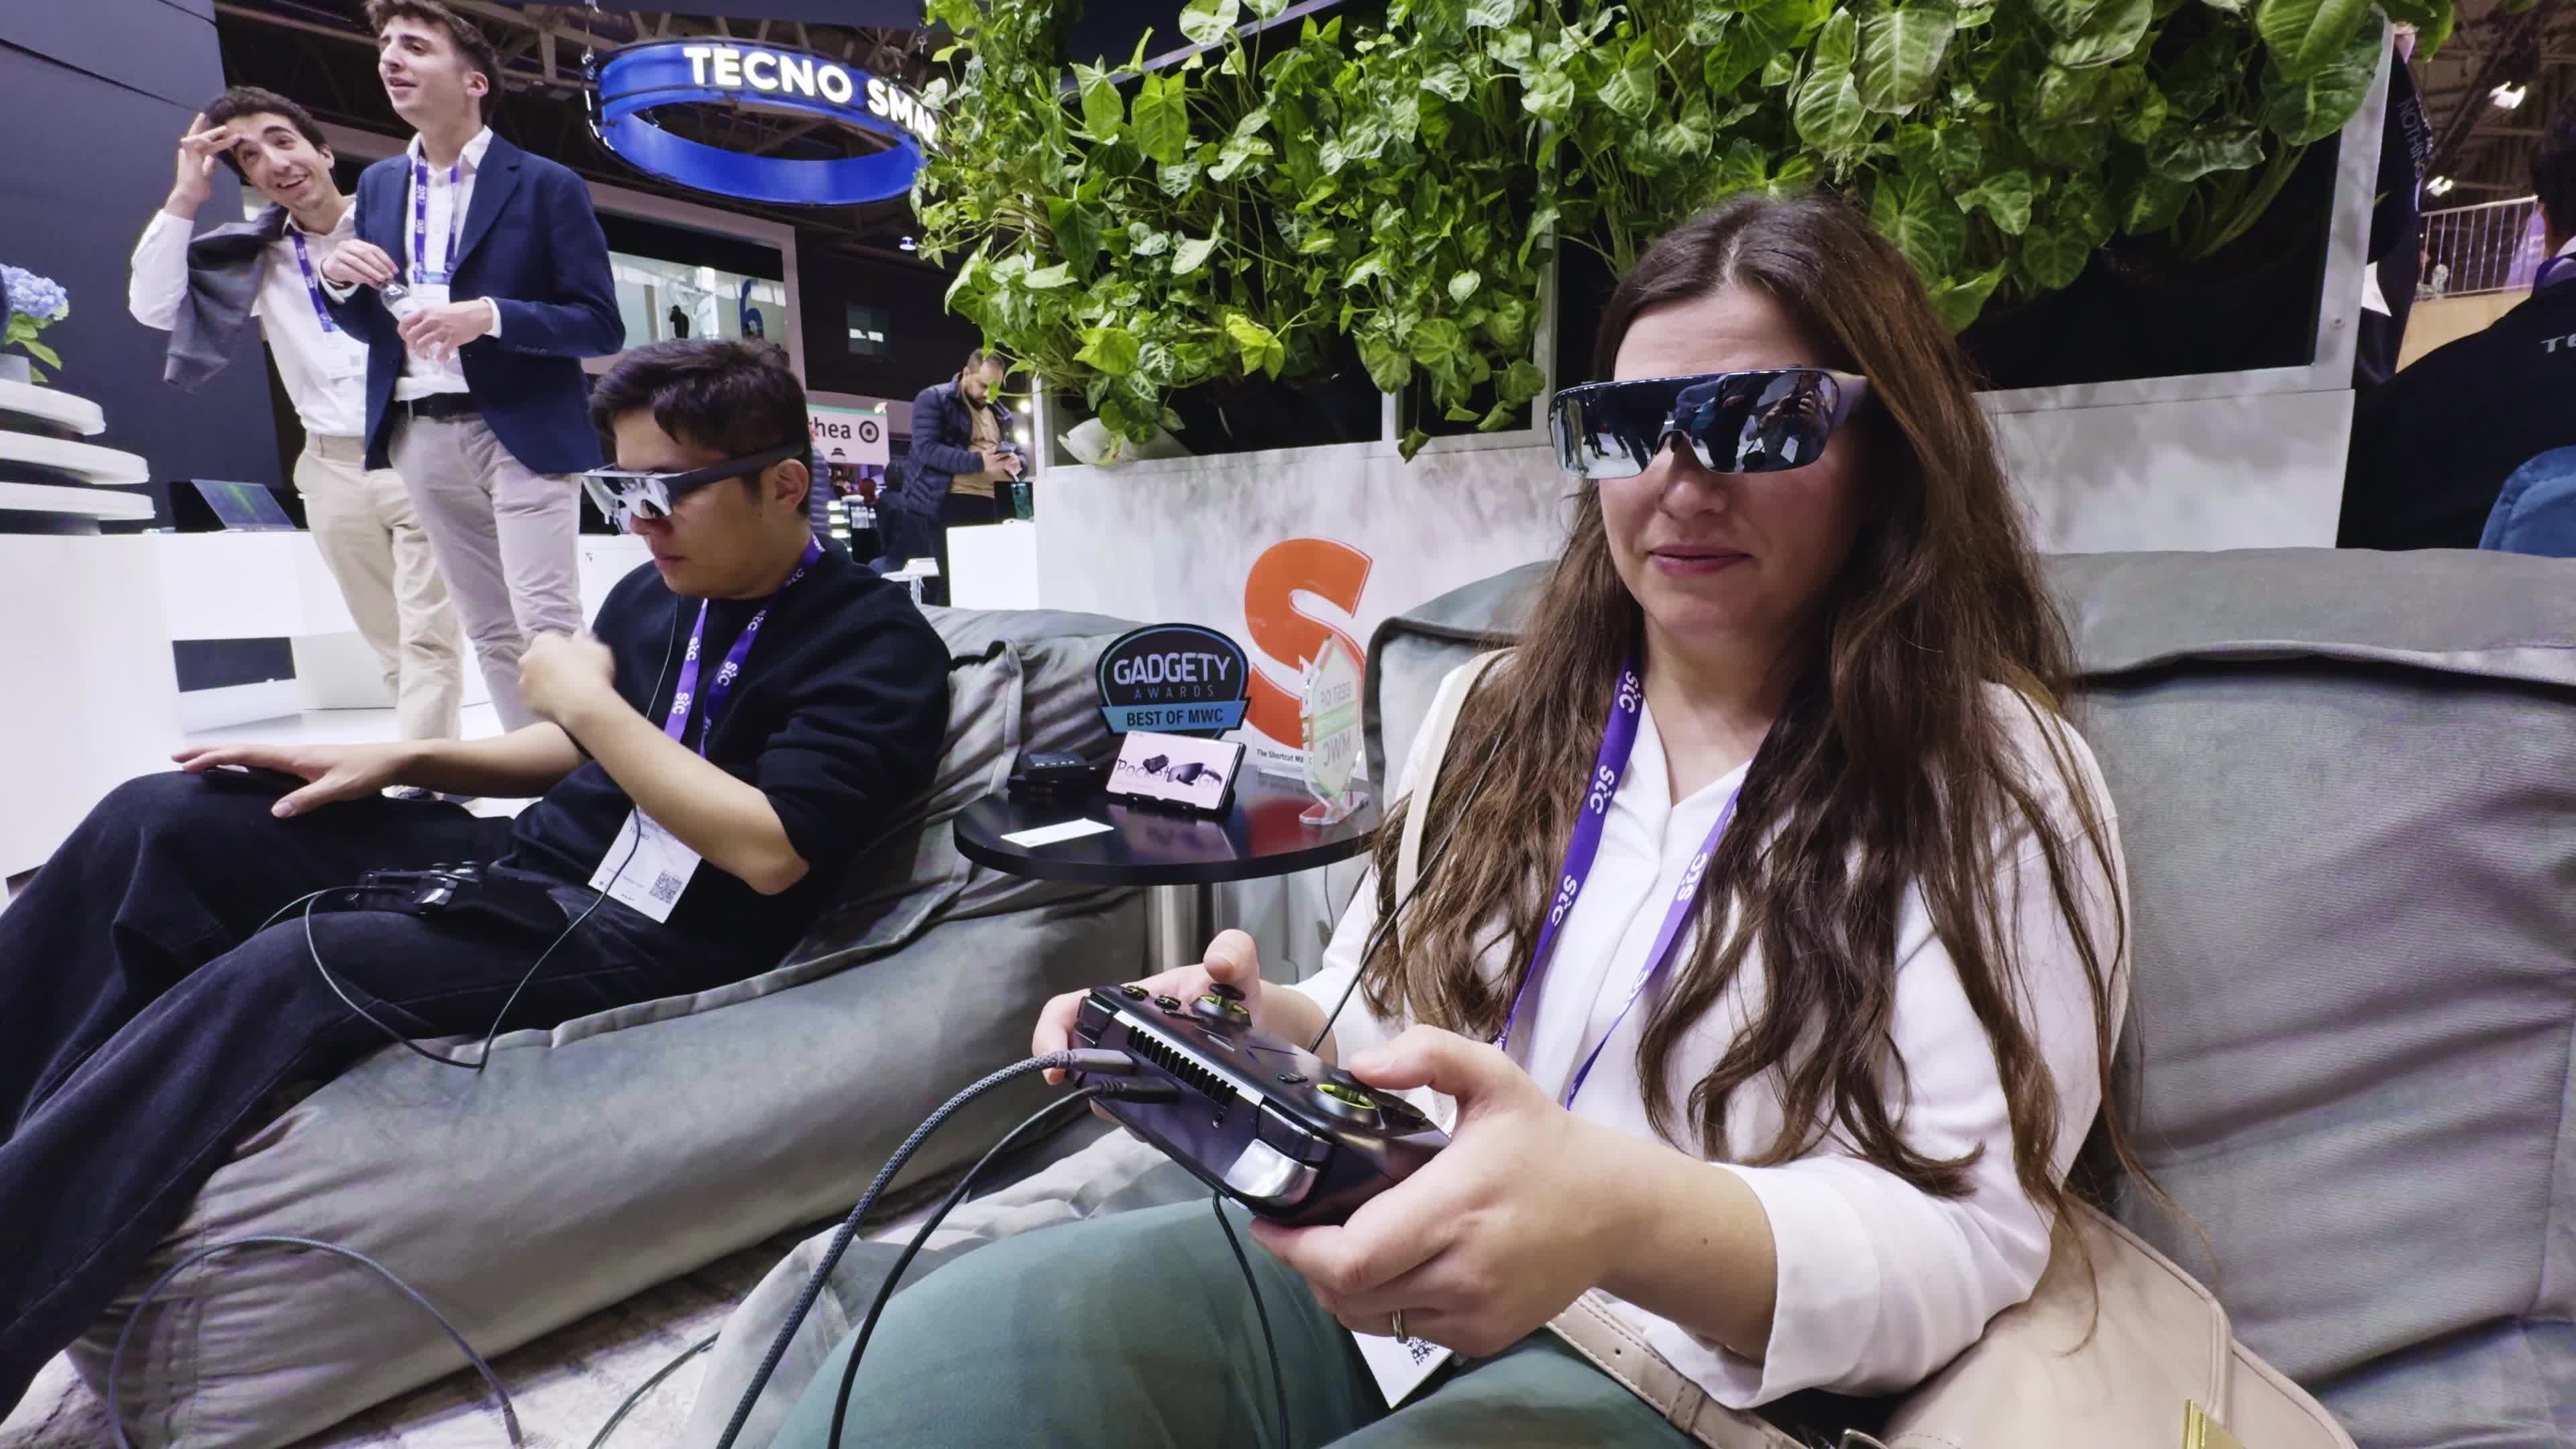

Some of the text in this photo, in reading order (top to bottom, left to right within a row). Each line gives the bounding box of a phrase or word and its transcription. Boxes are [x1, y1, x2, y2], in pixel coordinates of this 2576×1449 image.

[684, 47, 852, 104] TECNO
[809, 417, 851, 439] hea
[686, 637, 700, 661] stc
[717, 661, 738, 686] stc
[1114, 653, 1231, 685] GADGETY
[672, 692, 690, 714] stc
[1134, 685, 1214, 699] AWARDS
[1619, 671, 1642, 714] stc
[1127, 708, 1224, 727] BEST OF MWC
[1256, 748, 1267, 757] The
[1269, 751, 1294, 762] Shortcut
[1590, 765, 1615, 814] stc
[1677, 852, 1707, 901] stc
[1552, 875, 1576, 927] stc
